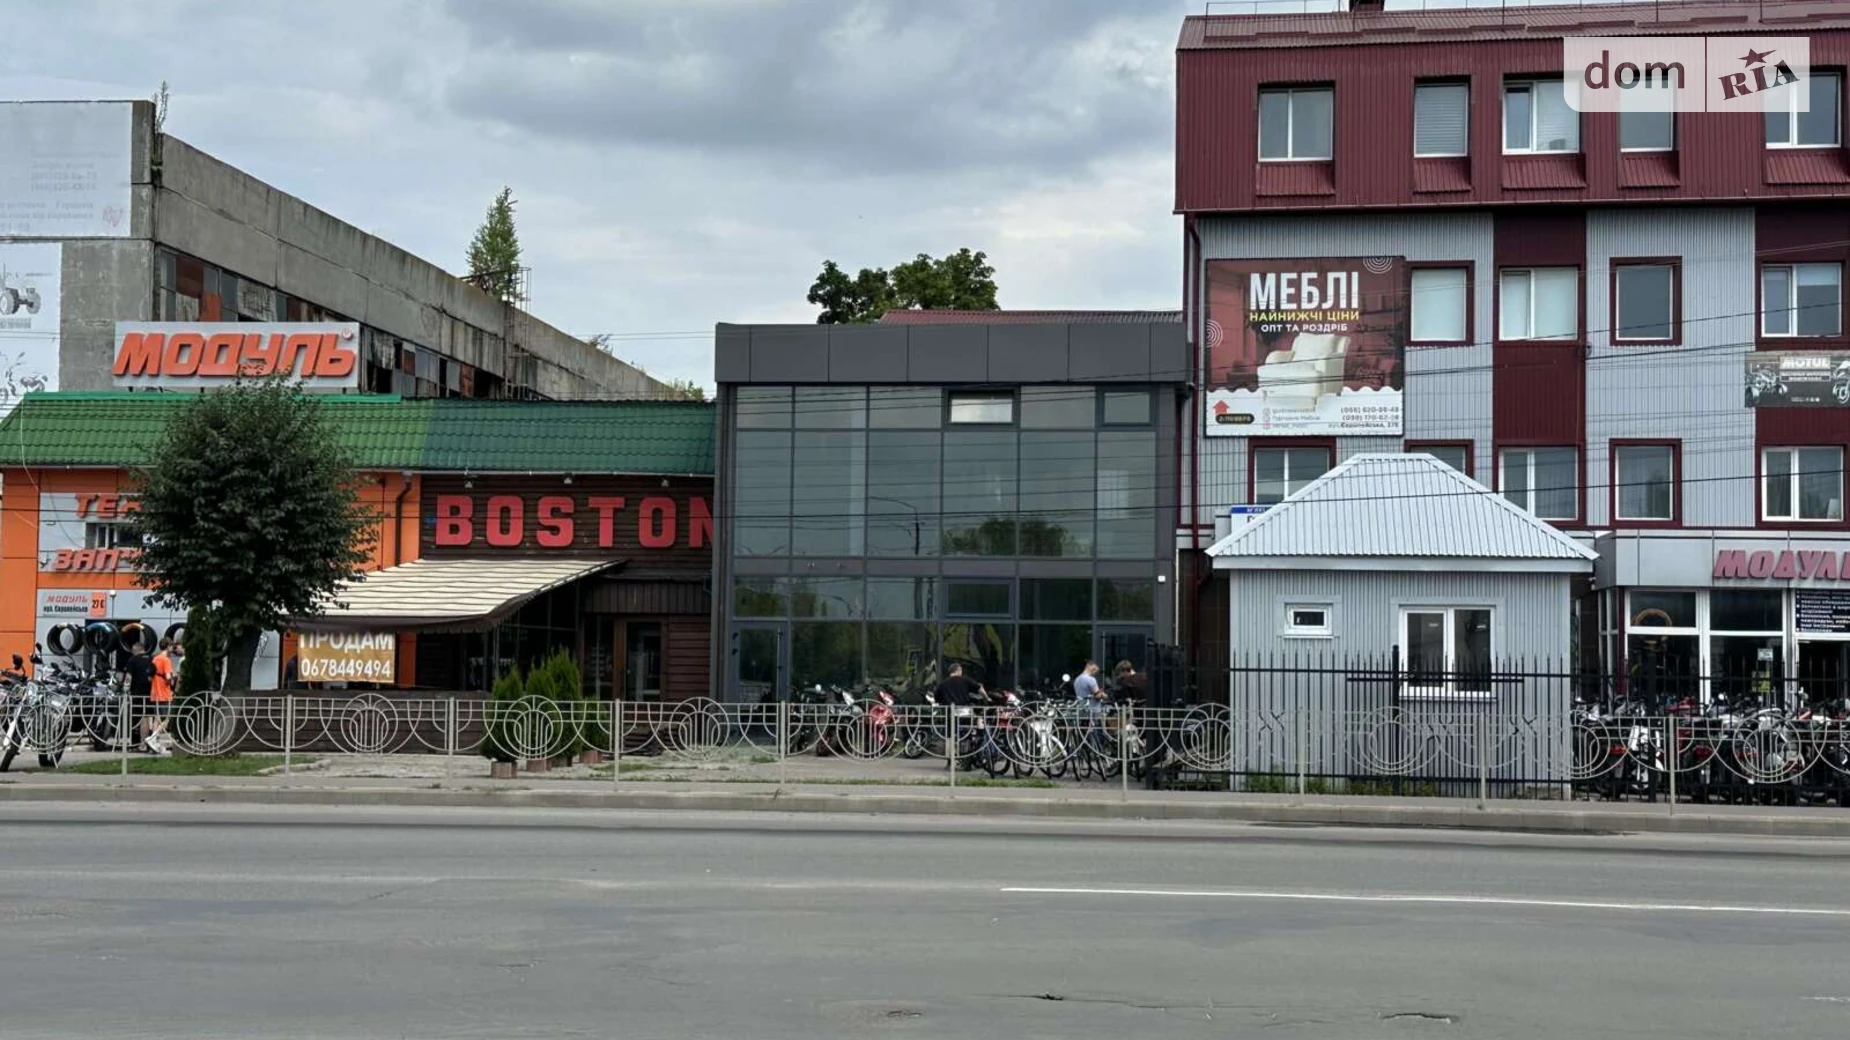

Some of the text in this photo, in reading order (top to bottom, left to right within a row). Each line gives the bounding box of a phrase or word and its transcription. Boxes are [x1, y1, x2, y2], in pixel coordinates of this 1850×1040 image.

[1250, 271, 1359, 310] МЕБЛІ
[1249, 310, 1360, 322] НАЙНИЖЧІ ЦІНИ
[1261, 323, 1348, 333] ОПТ ТА РОЗДРІБ
[111, 332, 358, 378] МОДУЛЬ
[436, 495, 714, 549] BOSTON
[301, 658, 391, 678] 0678449494
